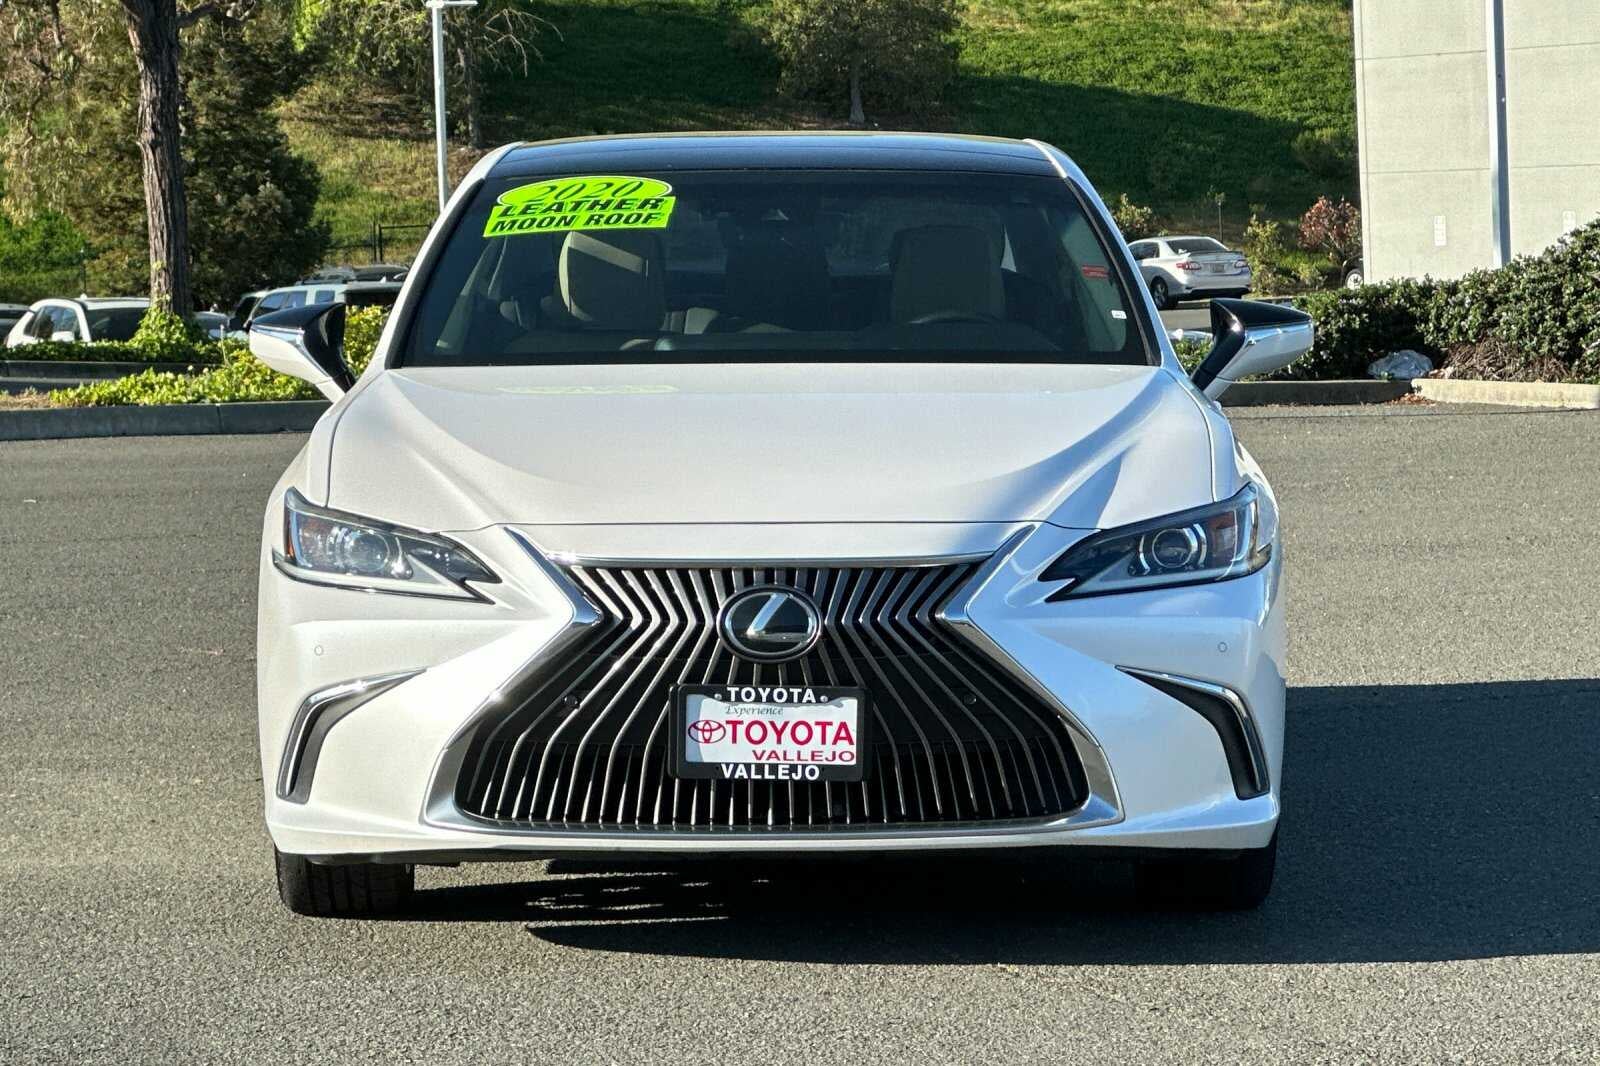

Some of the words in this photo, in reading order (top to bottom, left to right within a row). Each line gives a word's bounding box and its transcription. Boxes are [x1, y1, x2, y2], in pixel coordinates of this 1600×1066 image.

[523, 180, 643, 202] 2020
[498, 198, 664, 217] LEATHER
[491, 214, 576, 233] MOON
[584, 212, 660, 226] ROOF
[727, 687, 817, 703] TOYOTA
[725, 704, 784, 717] Experience
[725, 720, 855, 746] TOYOTA
[752, 750, 855, 762] VALLEJO
[721, 764, 820, 780] VALLEJO
